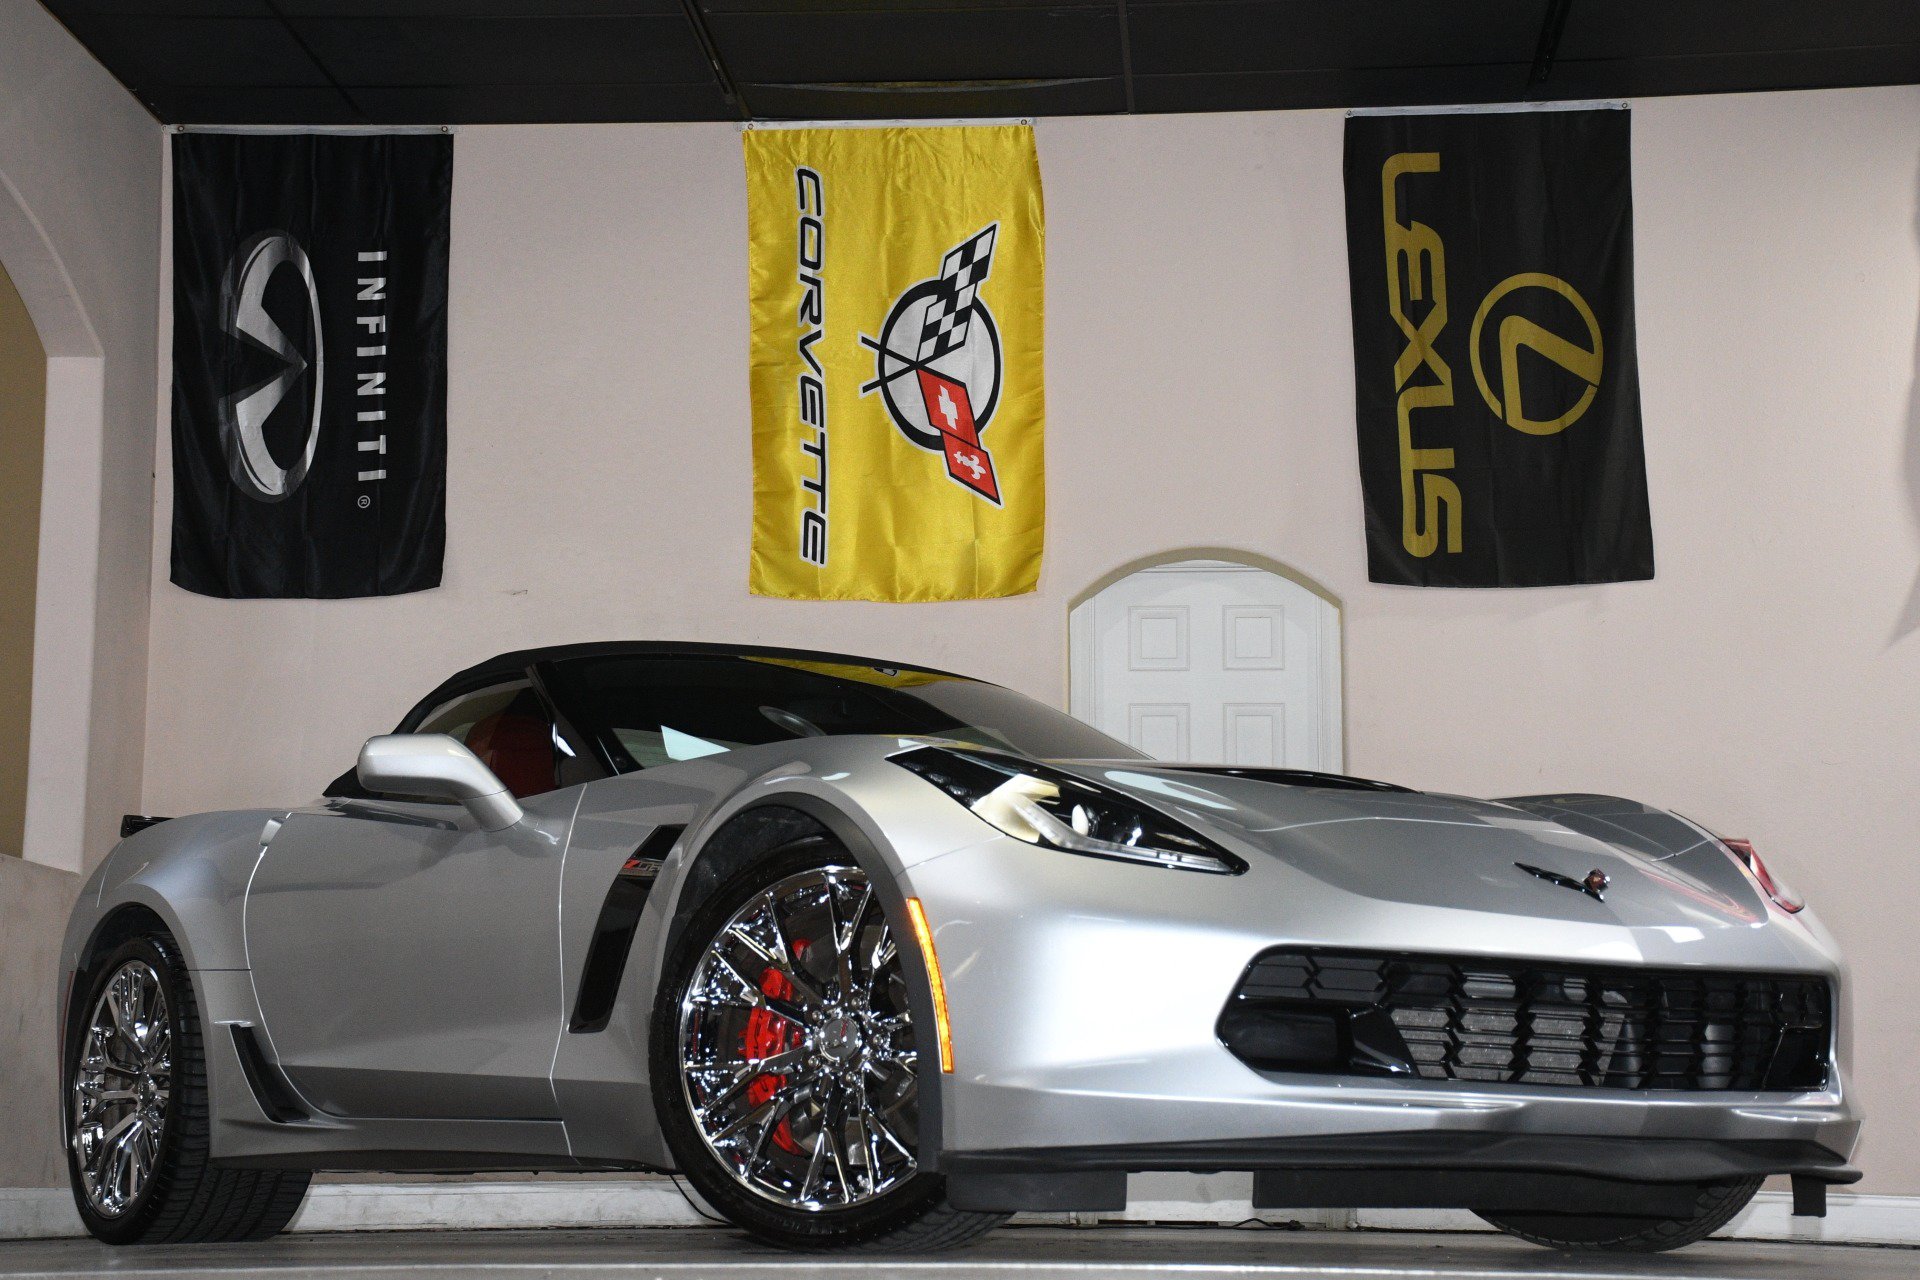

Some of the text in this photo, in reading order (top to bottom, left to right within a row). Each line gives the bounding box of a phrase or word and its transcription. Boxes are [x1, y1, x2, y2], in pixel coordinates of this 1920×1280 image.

[356, 250, 388, 482] INFINITI
[795, 166, 827, 566] CORVETTE
[1381, 152, 1463, 558] LEXUS
